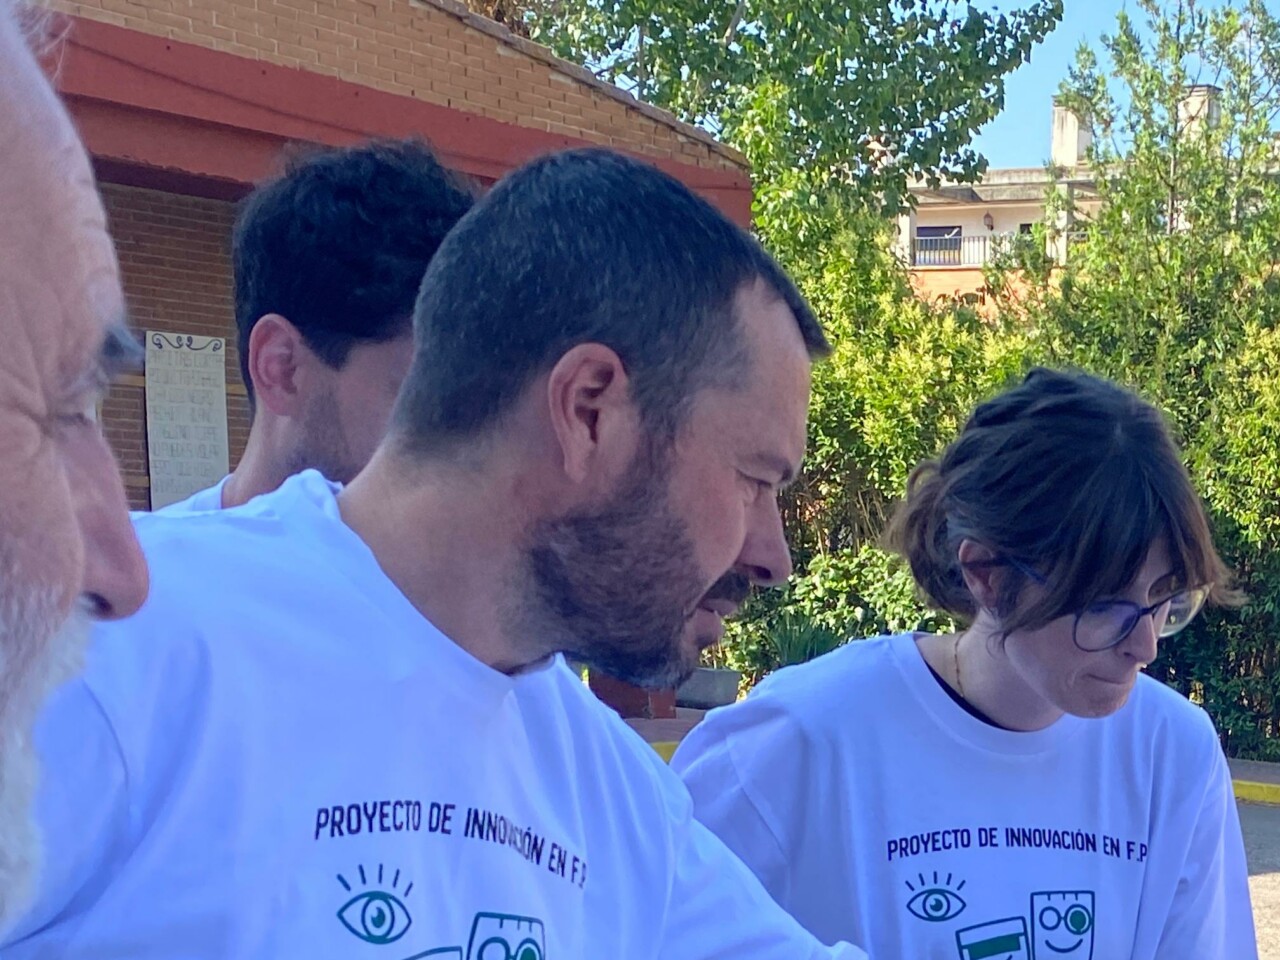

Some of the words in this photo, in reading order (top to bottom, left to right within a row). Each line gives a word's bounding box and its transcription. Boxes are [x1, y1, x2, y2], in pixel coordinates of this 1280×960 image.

[315, 800, 421, 840] PROYECTO
[428, 802, 456, 835] DE
[548, 842, 567, 878] EN
[888, 829, 971, 861] PROYECTO
[978, 828, 998, 847] DE
[1005, 828, 1097, 853] INNOVACIÓN
[1103, 836, 1121, 858] EN
